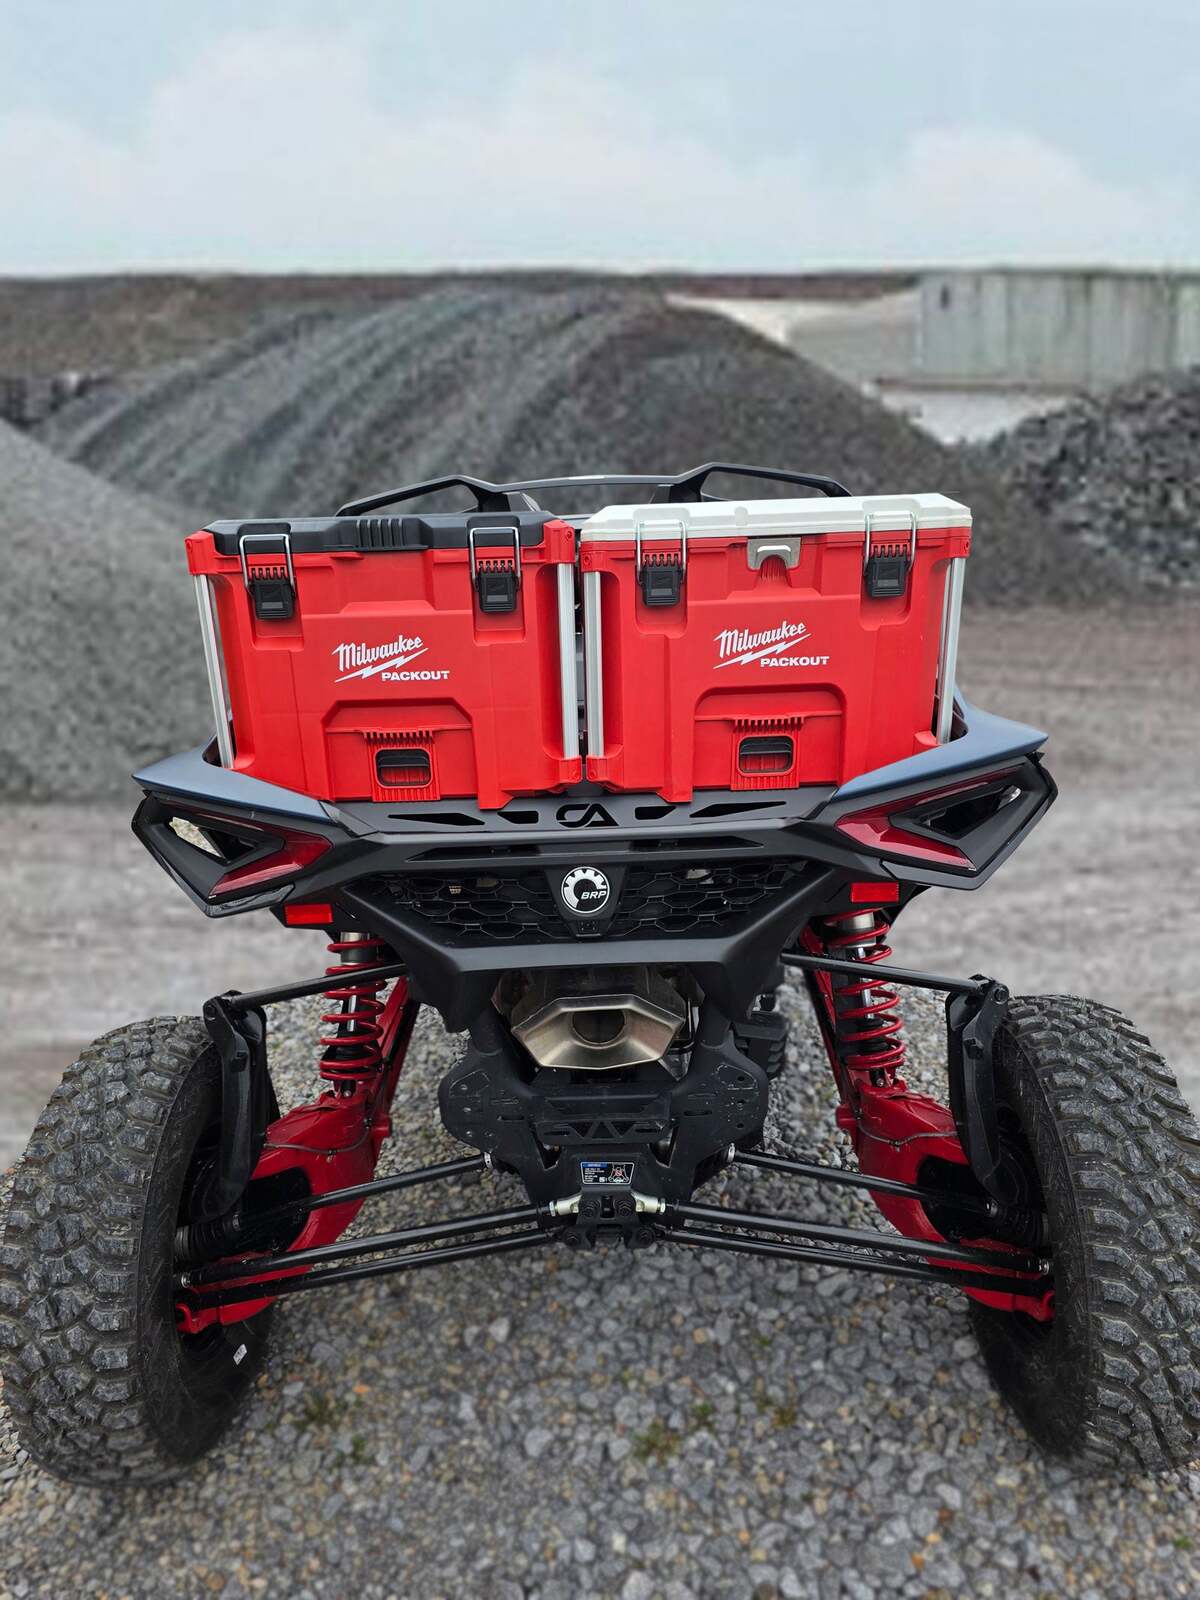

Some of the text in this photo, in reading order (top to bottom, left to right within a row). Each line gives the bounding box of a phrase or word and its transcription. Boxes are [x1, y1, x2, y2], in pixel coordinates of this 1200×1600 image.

[713, 620, 807, 659] Milwaukee
[331, 634, 424, 673] Milwaukee
[760, 655, 830, 668] PACKOUT
[381, 670, 450, 682] PACKOUT
[580, 891, 607, 900] BRP
